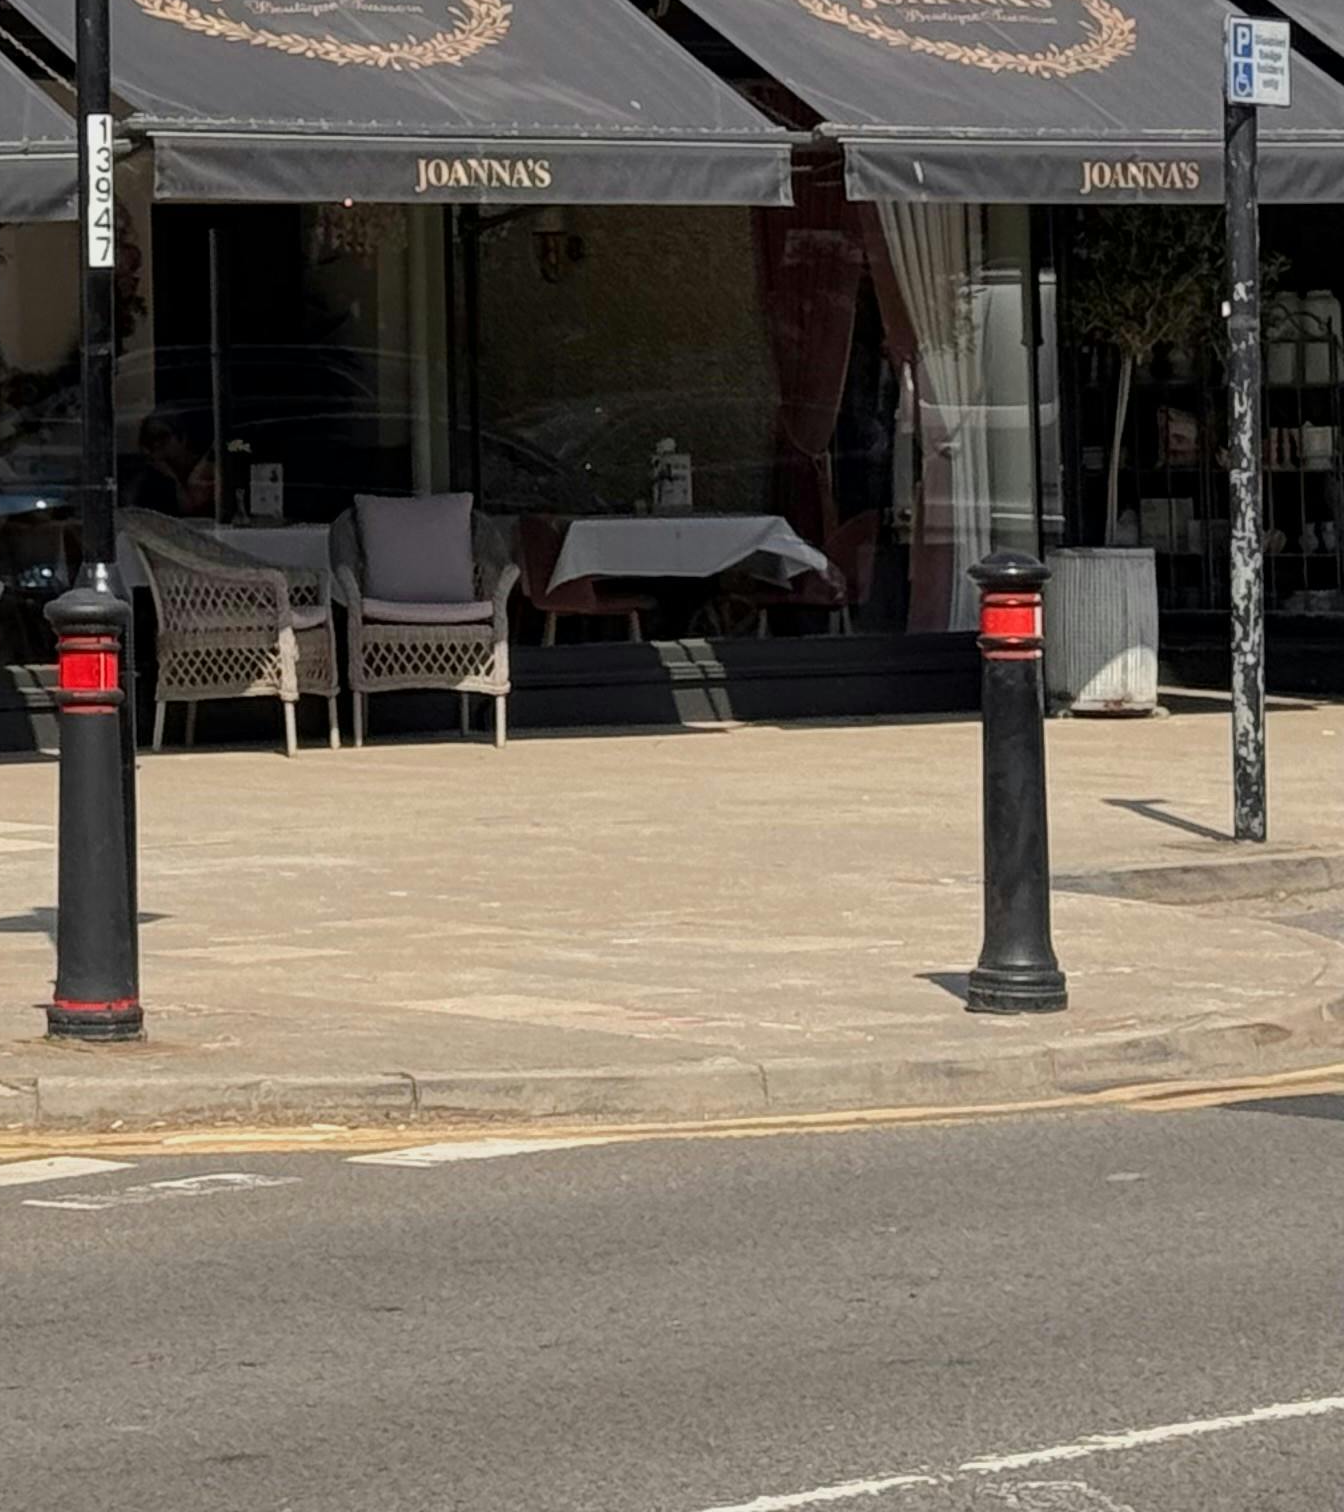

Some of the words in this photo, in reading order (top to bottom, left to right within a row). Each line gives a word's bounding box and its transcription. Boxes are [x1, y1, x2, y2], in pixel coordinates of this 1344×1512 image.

[1236, 25, 1251, 56] P
[94, 117, 111, 262] 13947
[416, 158, 552, 191] JOANNA'S
[1081, 162, 1200, 193] JOANNA'S
